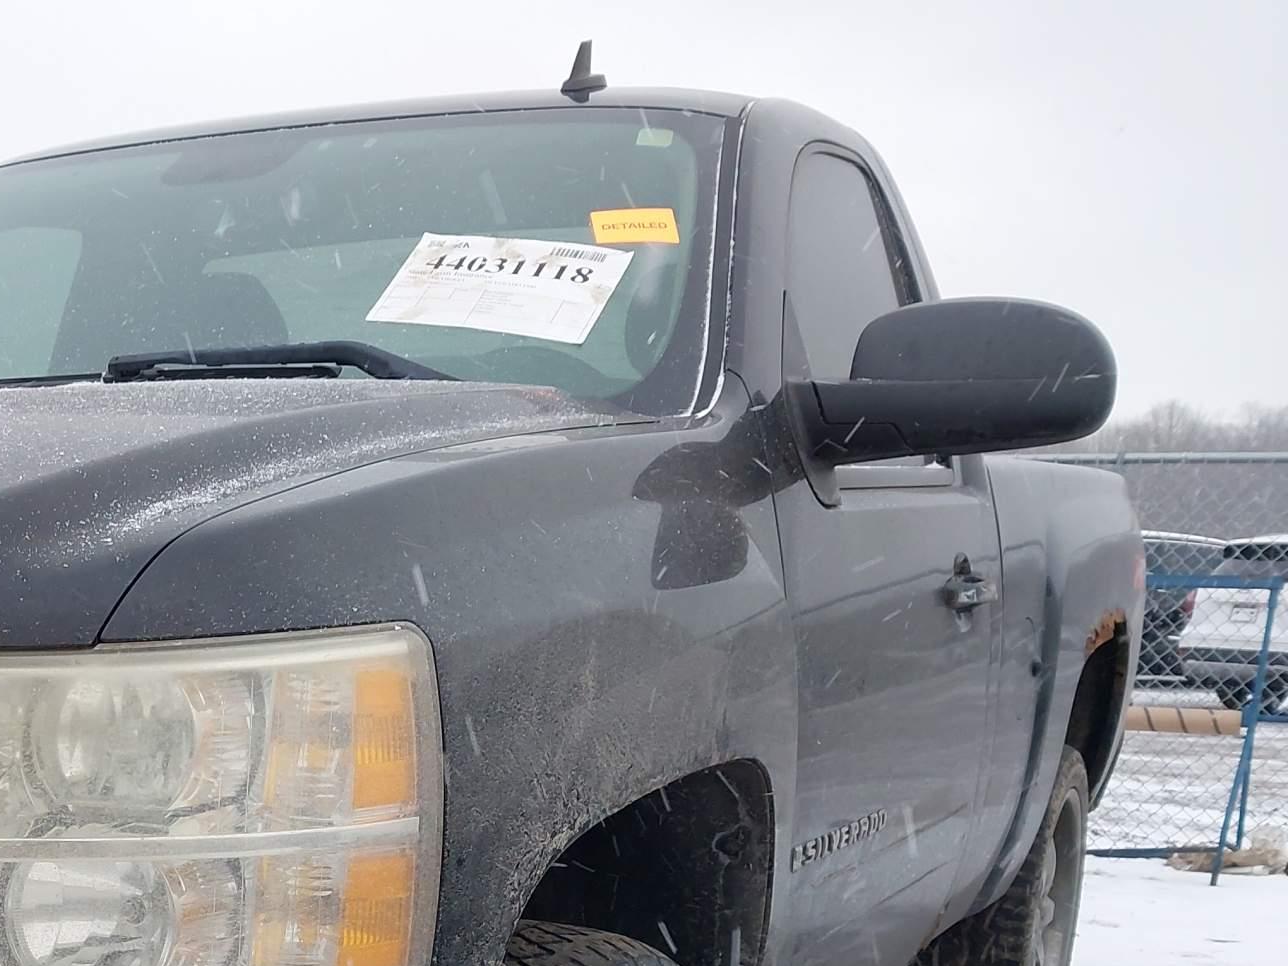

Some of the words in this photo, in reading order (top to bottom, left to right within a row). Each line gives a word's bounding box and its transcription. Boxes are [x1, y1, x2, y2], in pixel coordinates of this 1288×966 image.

[600, 220, 669, 231] DETAILED
[425, 253, 594, 284] 44031118
[802, 808, 888, 866] SILVERADO
